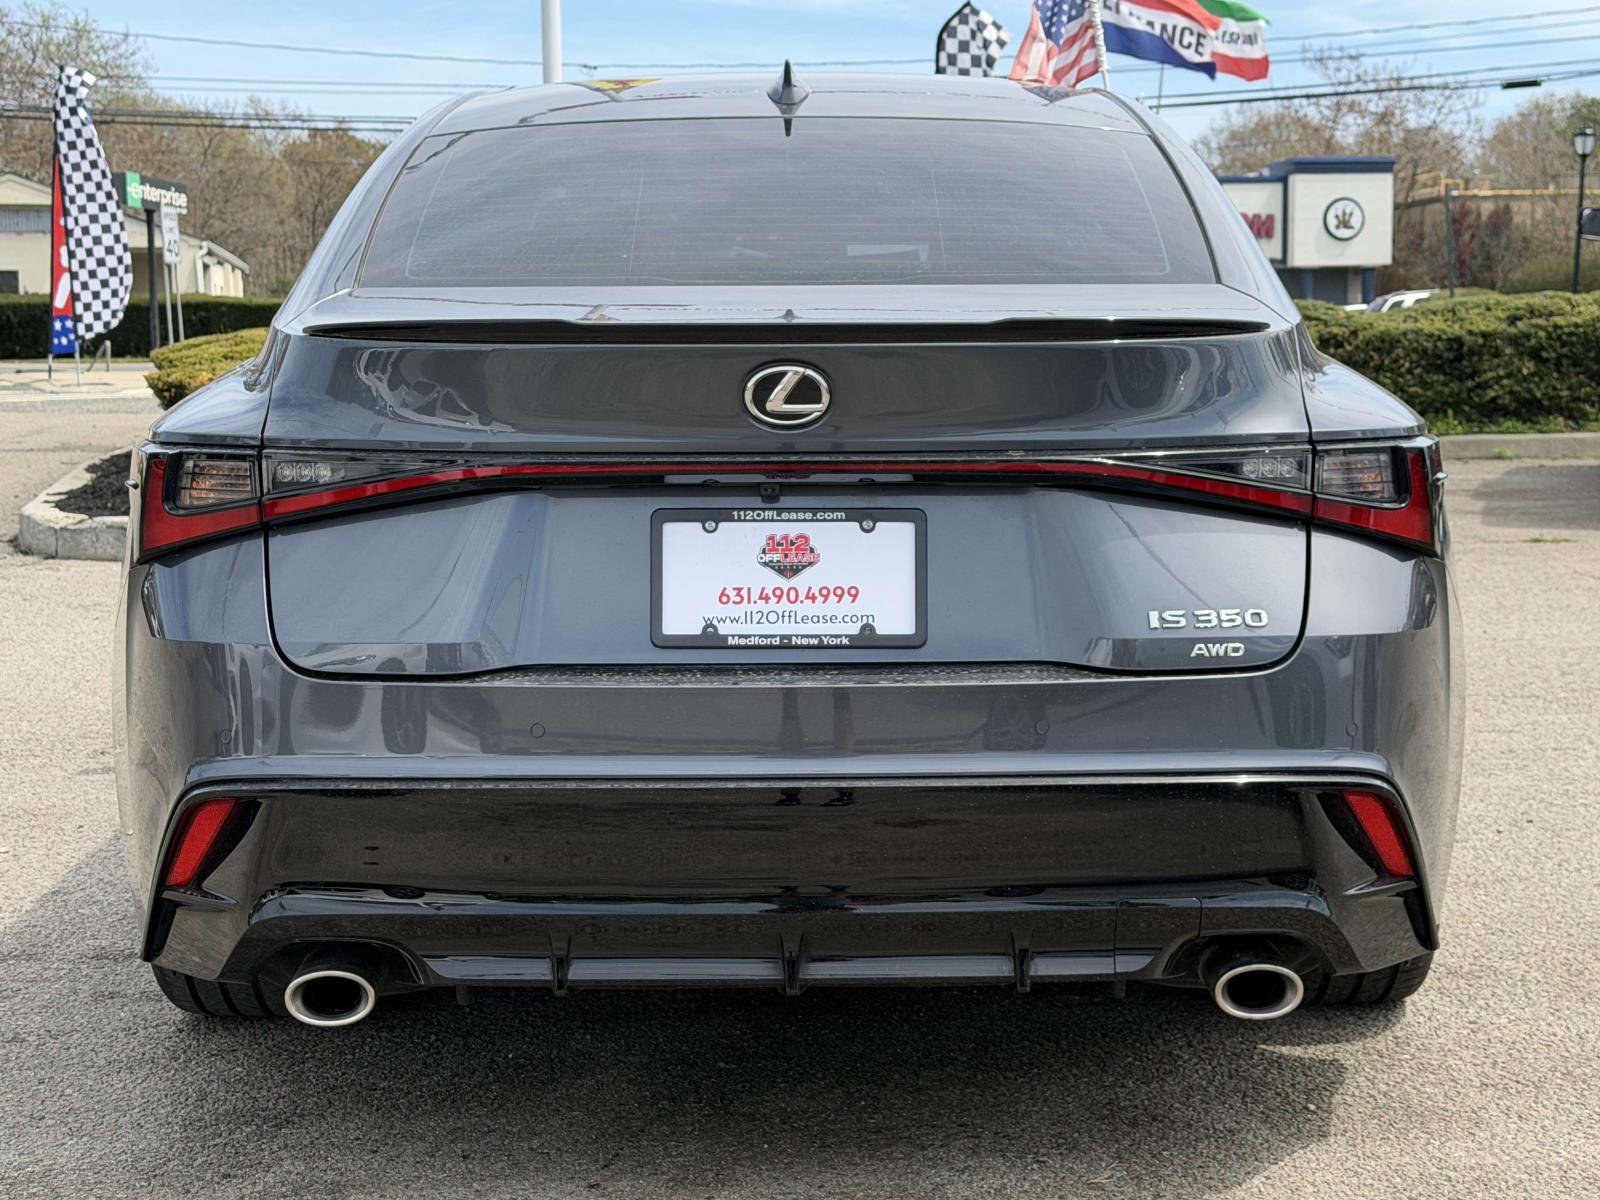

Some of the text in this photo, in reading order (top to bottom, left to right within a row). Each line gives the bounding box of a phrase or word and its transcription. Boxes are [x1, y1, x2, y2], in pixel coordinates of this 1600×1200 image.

[129, 182, 188, 207] enterprise
[166, 239, 180, 257] 40
[732, 510, 846, 521] 112OffLease.com
[766, 533, 811, 554] 112
[718, 585, 860, 605] 631.490.4999
[702, 609, 875, 625] www.112OffLease.com
[1148, 608, 1269, 629] IS 350
[728, 635, 780, 646] Medford
[791, 635, 819, 646] New
[821, 635, 850, 646] York
[1190, 642, 1246, 658] AWD
